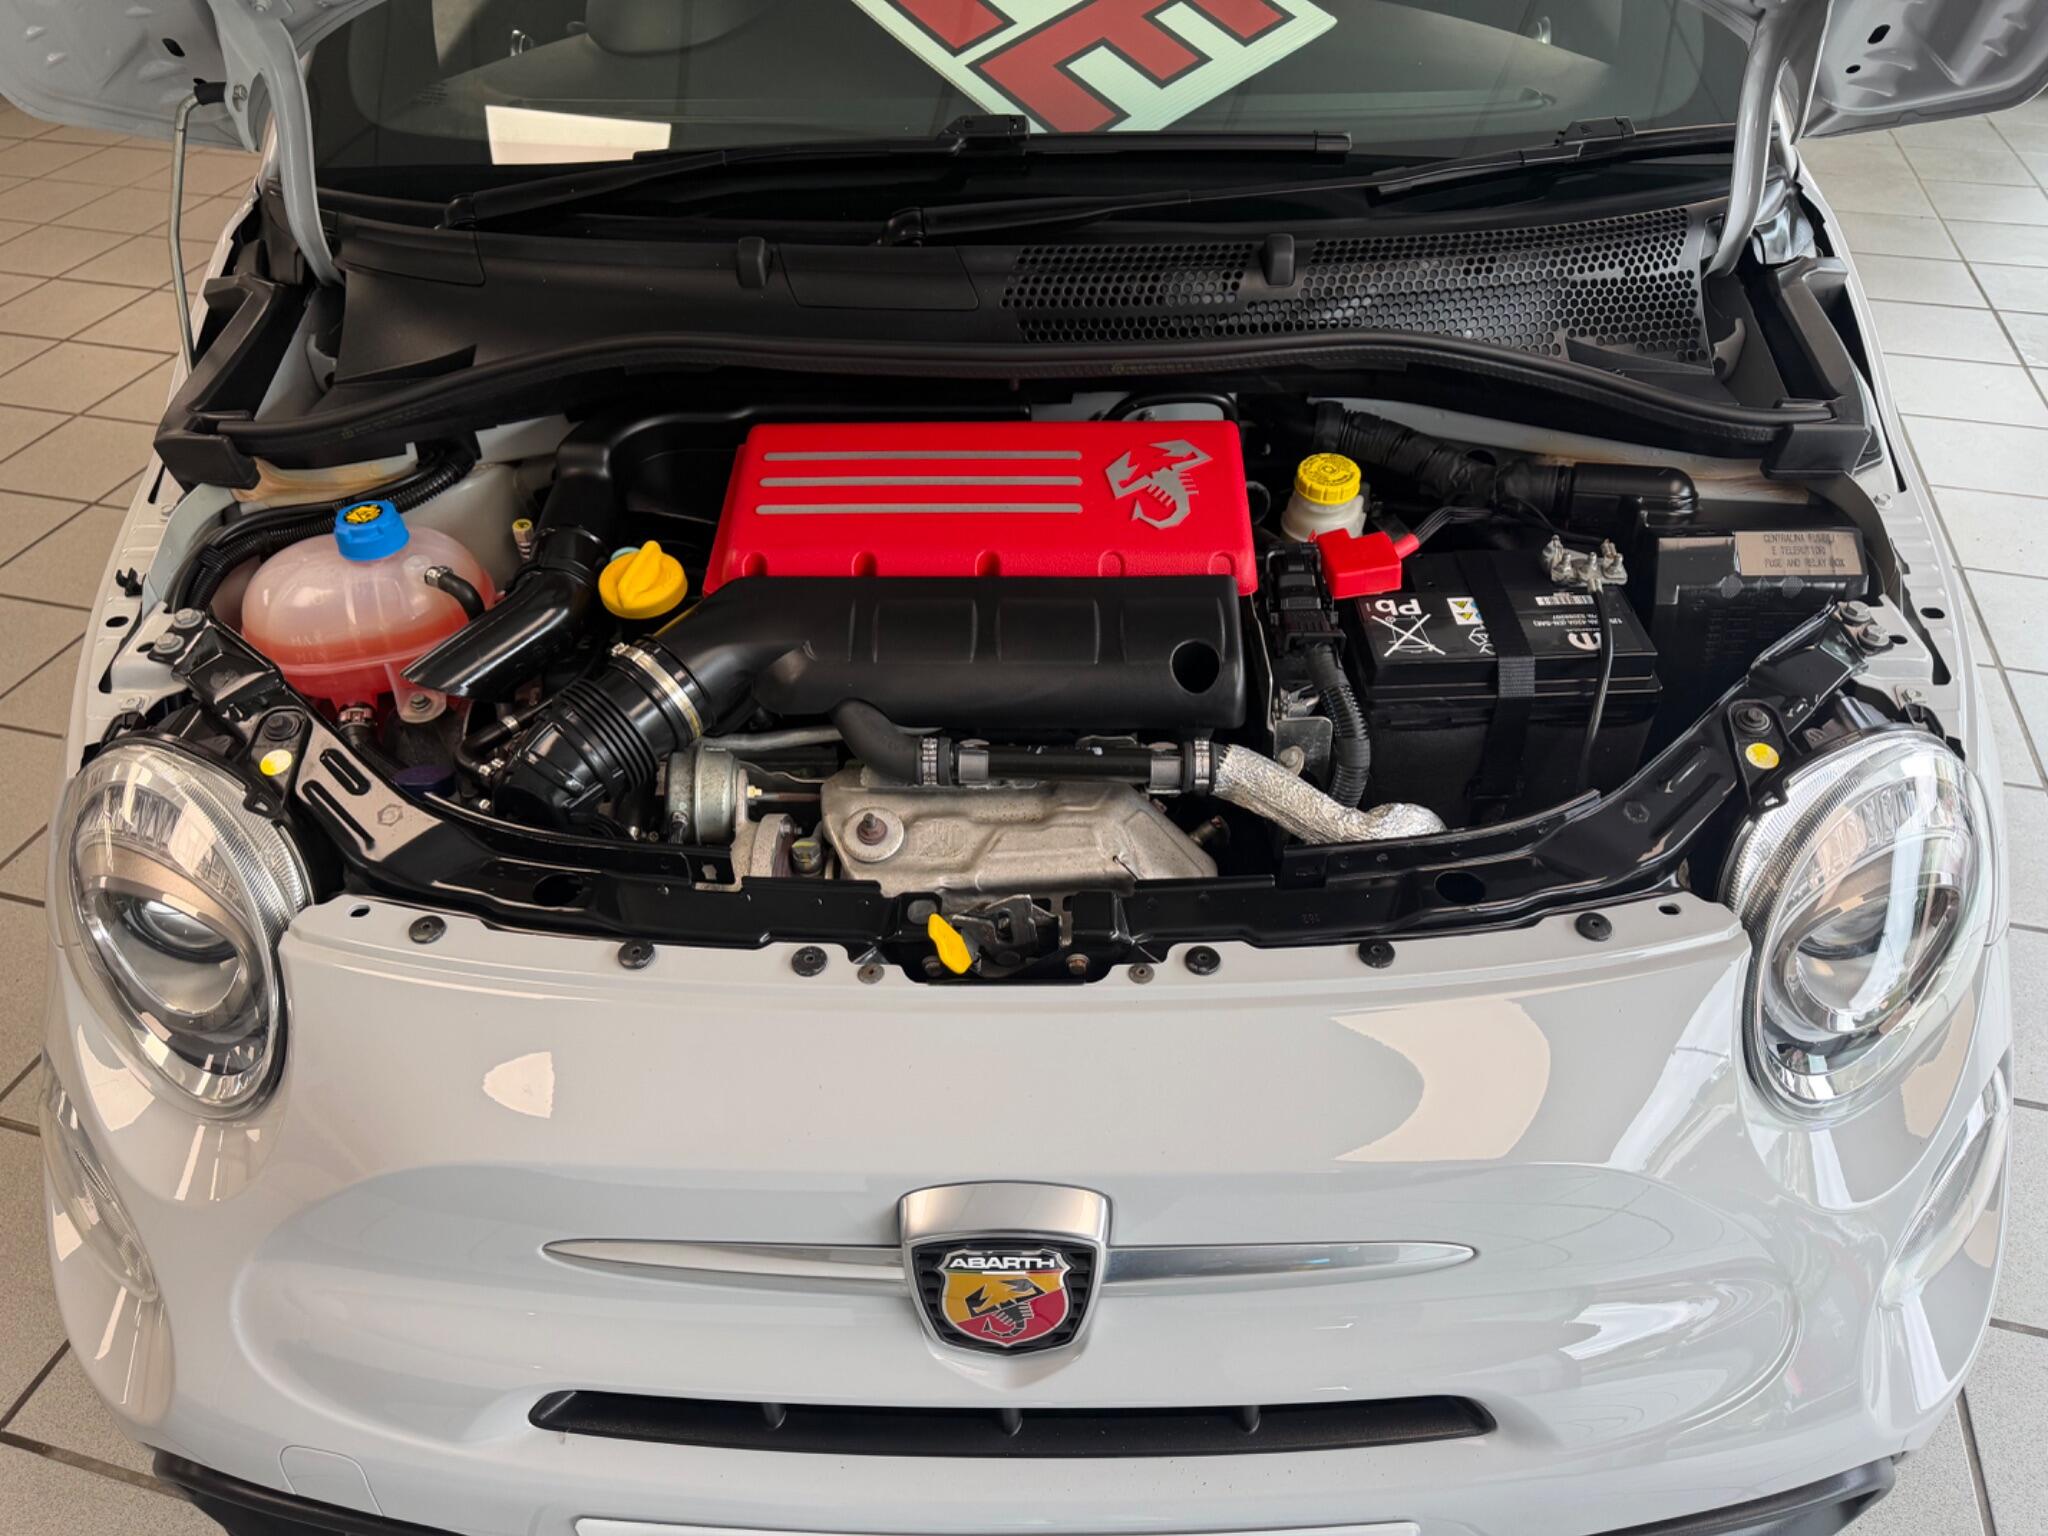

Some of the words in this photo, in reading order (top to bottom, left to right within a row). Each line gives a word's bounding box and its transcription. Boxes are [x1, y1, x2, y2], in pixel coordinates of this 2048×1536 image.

[1763, 533, 1805, 544] CENTRALINA
[1764, 558, 1782, 569] FUSE
[1786, 558, 1801, 569] AND
[1805, 558, 1827, 569] RELAY
[1829, 557, 1846, 568] BOX
[1375, 598, 1422, 617] Pb
[949, 1256, 1055, 1270] ABARTH
